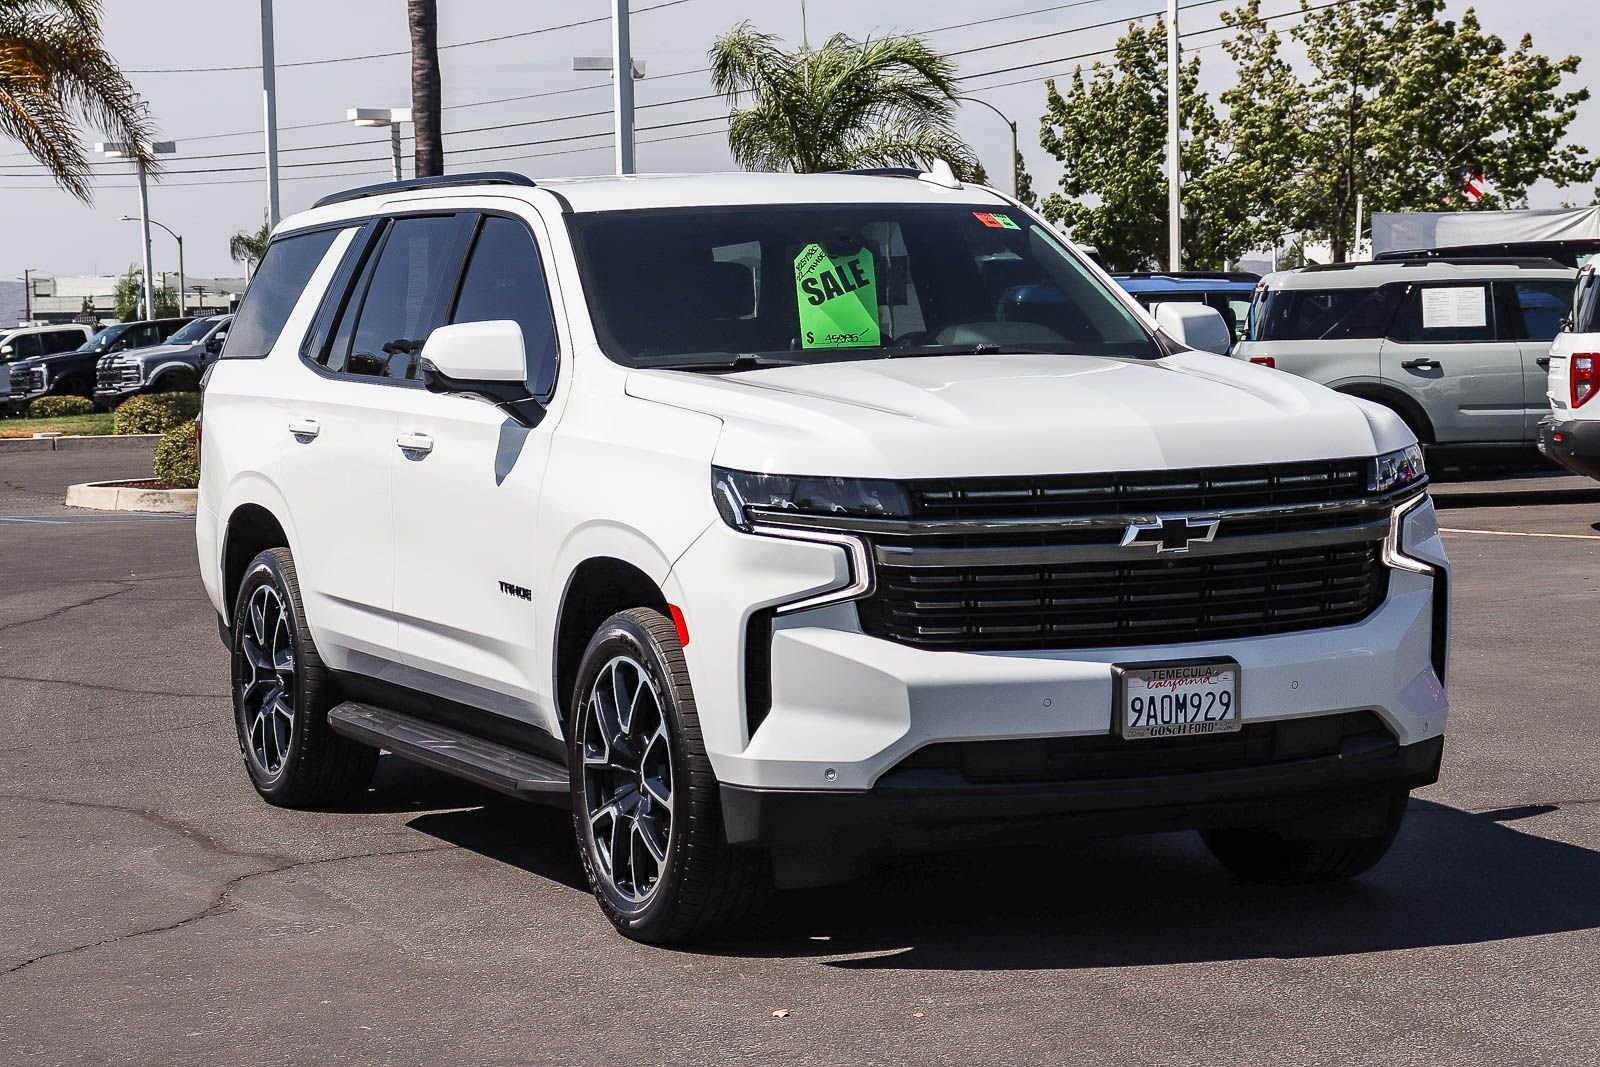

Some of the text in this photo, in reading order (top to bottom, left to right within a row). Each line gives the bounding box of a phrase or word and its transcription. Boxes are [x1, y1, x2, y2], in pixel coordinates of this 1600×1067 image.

[801, 258, 870, 306] SALE
[806, 331, 815, 344] $
[498, 580, 532, 602] TAHOE
[1152, 667, 1212, 680] TEMECULA
[1188, 722, 1214, 734] FORD
